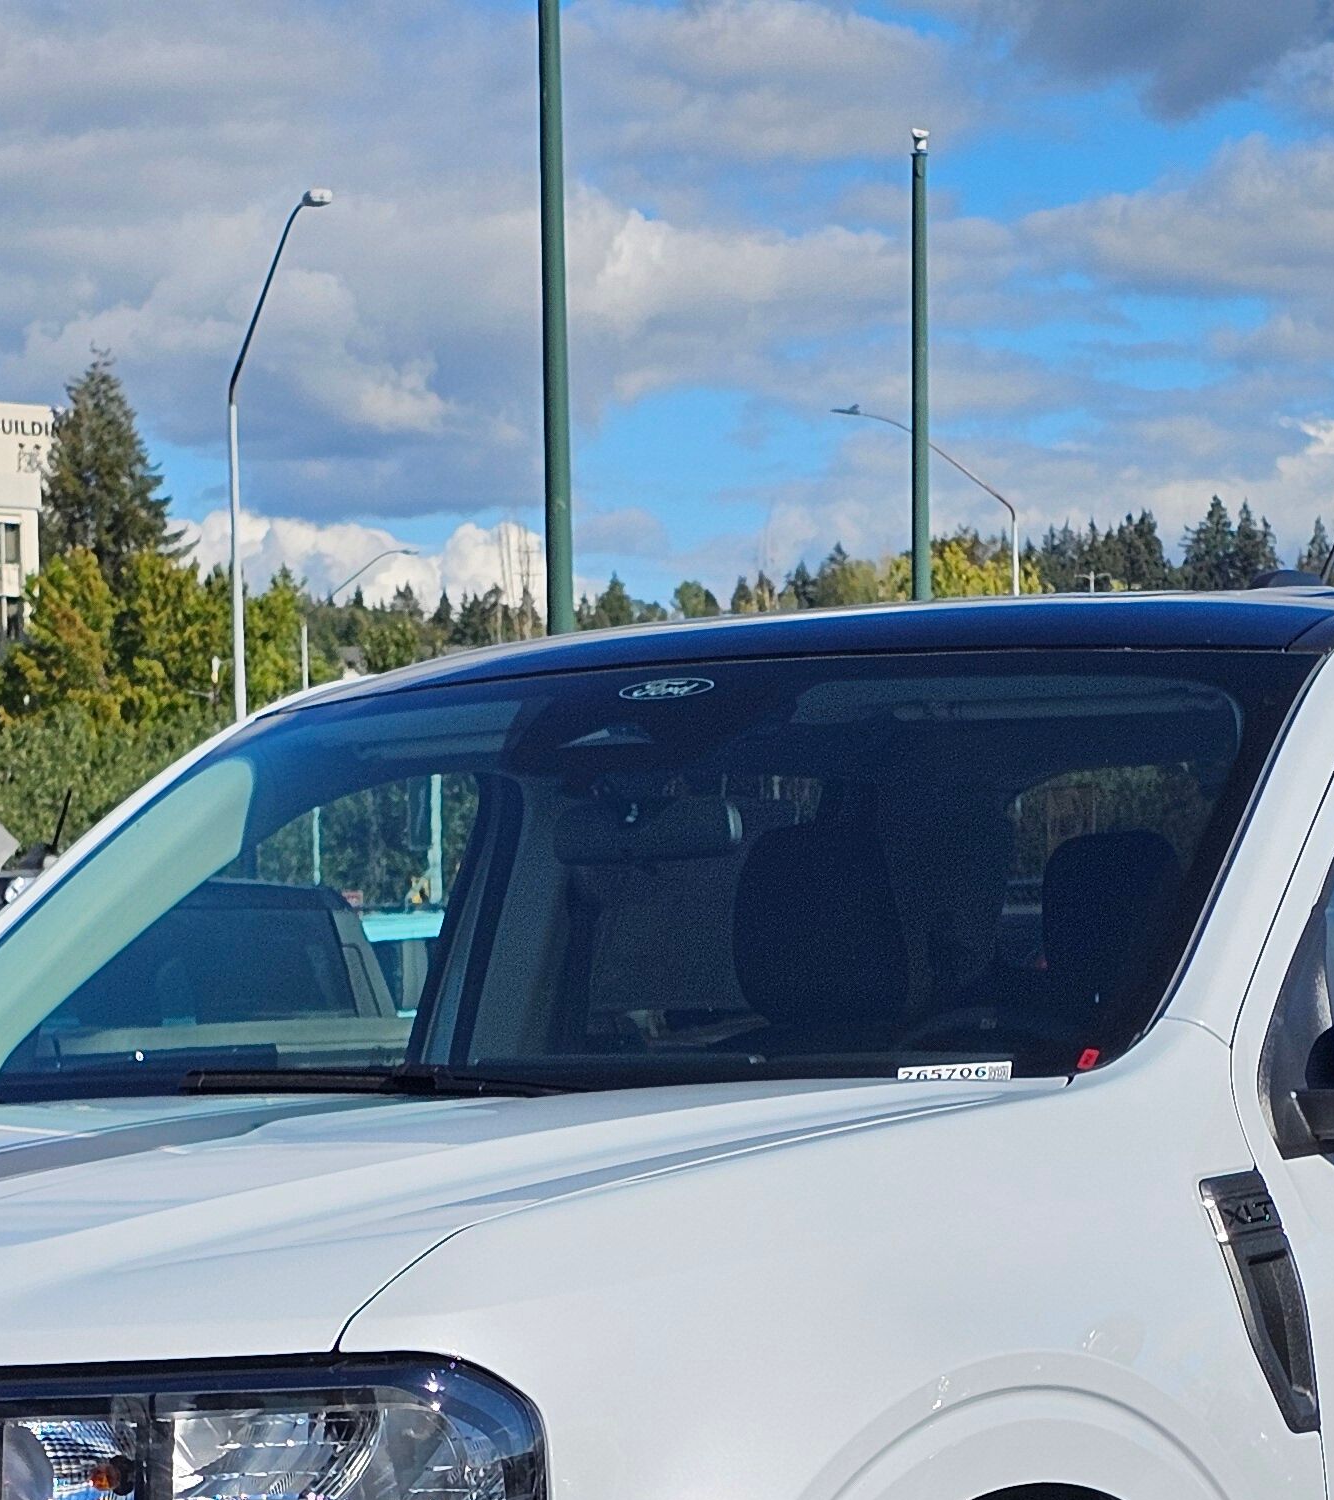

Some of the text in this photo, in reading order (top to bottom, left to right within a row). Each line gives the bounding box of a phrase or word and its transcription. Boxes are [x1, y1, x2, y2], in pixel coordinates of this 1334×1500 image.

[632, 680, 699, 697] Ford
[901, 1066, 988, 1080] 265706
[1222, 1200, 1273, 1227] XLT
